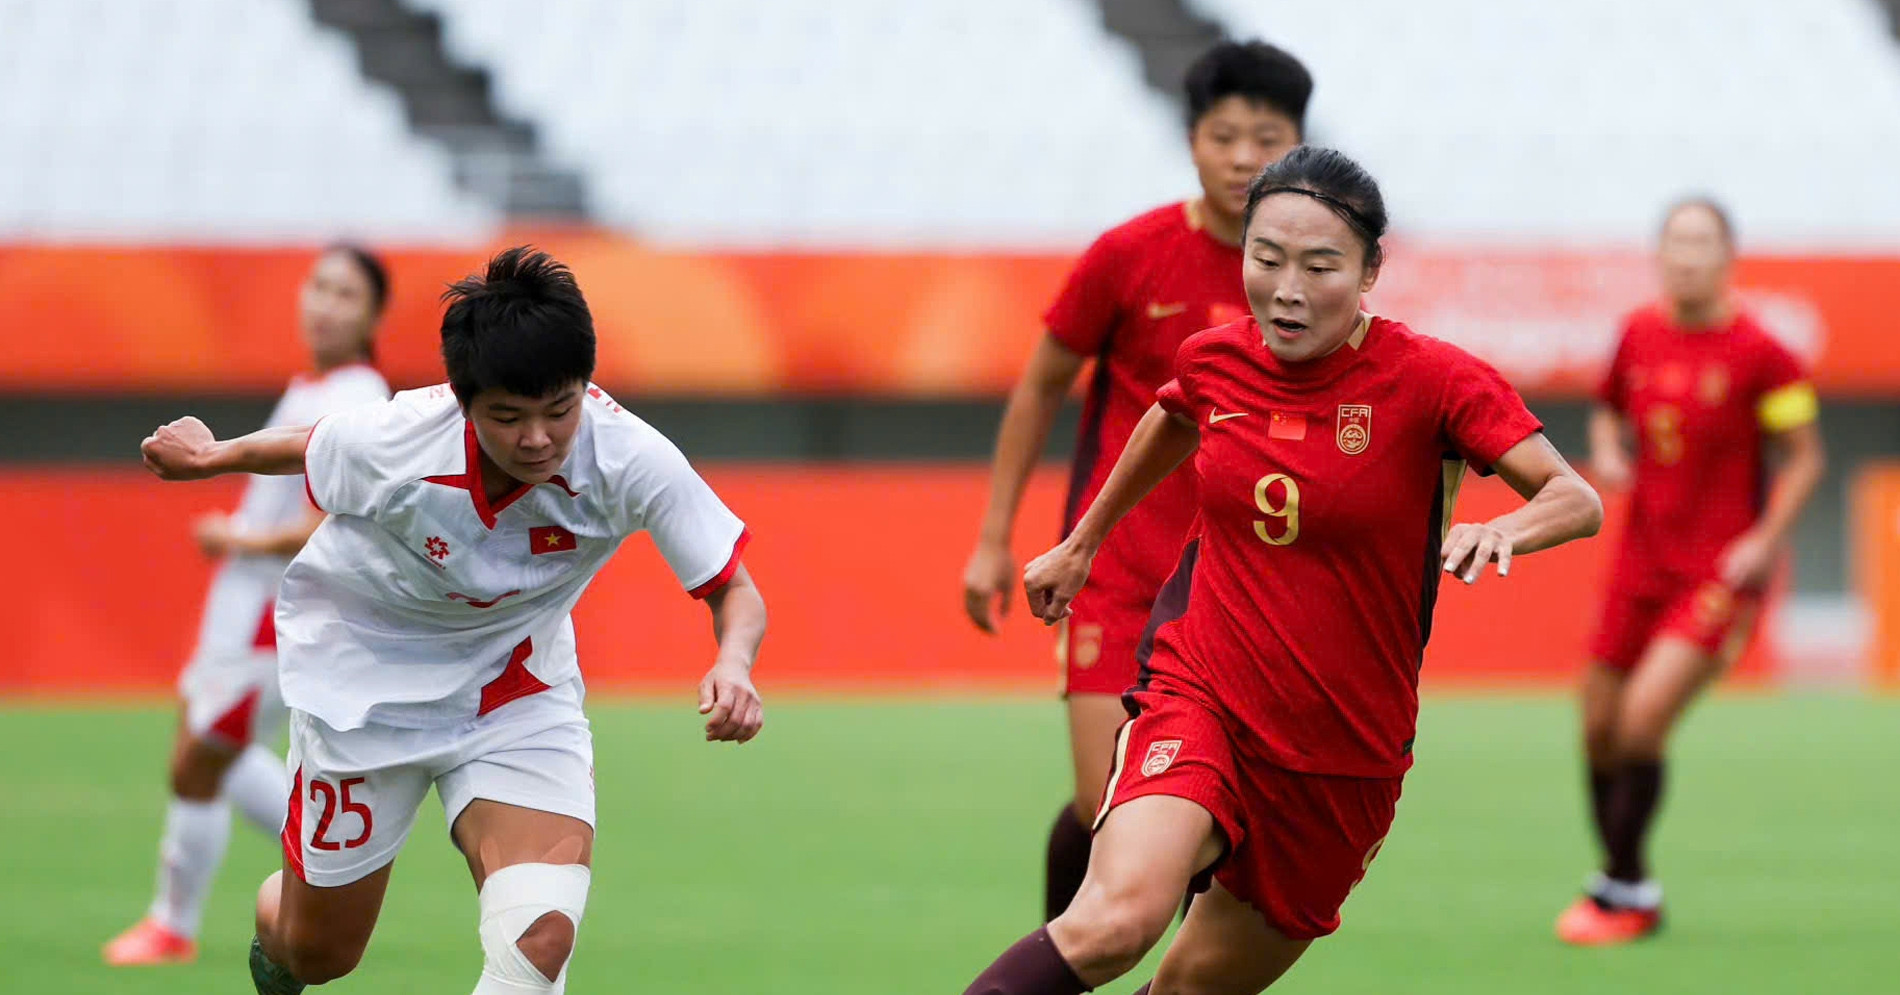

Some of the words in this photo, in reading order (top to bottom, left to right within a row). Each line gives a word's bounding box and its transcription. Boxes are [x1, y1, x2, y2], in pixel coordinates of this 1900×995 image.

[1341, 408, 1368, 417] CFA
[1253, 473, 1300, 545] 9
[310, 777, 373, 850] 25
